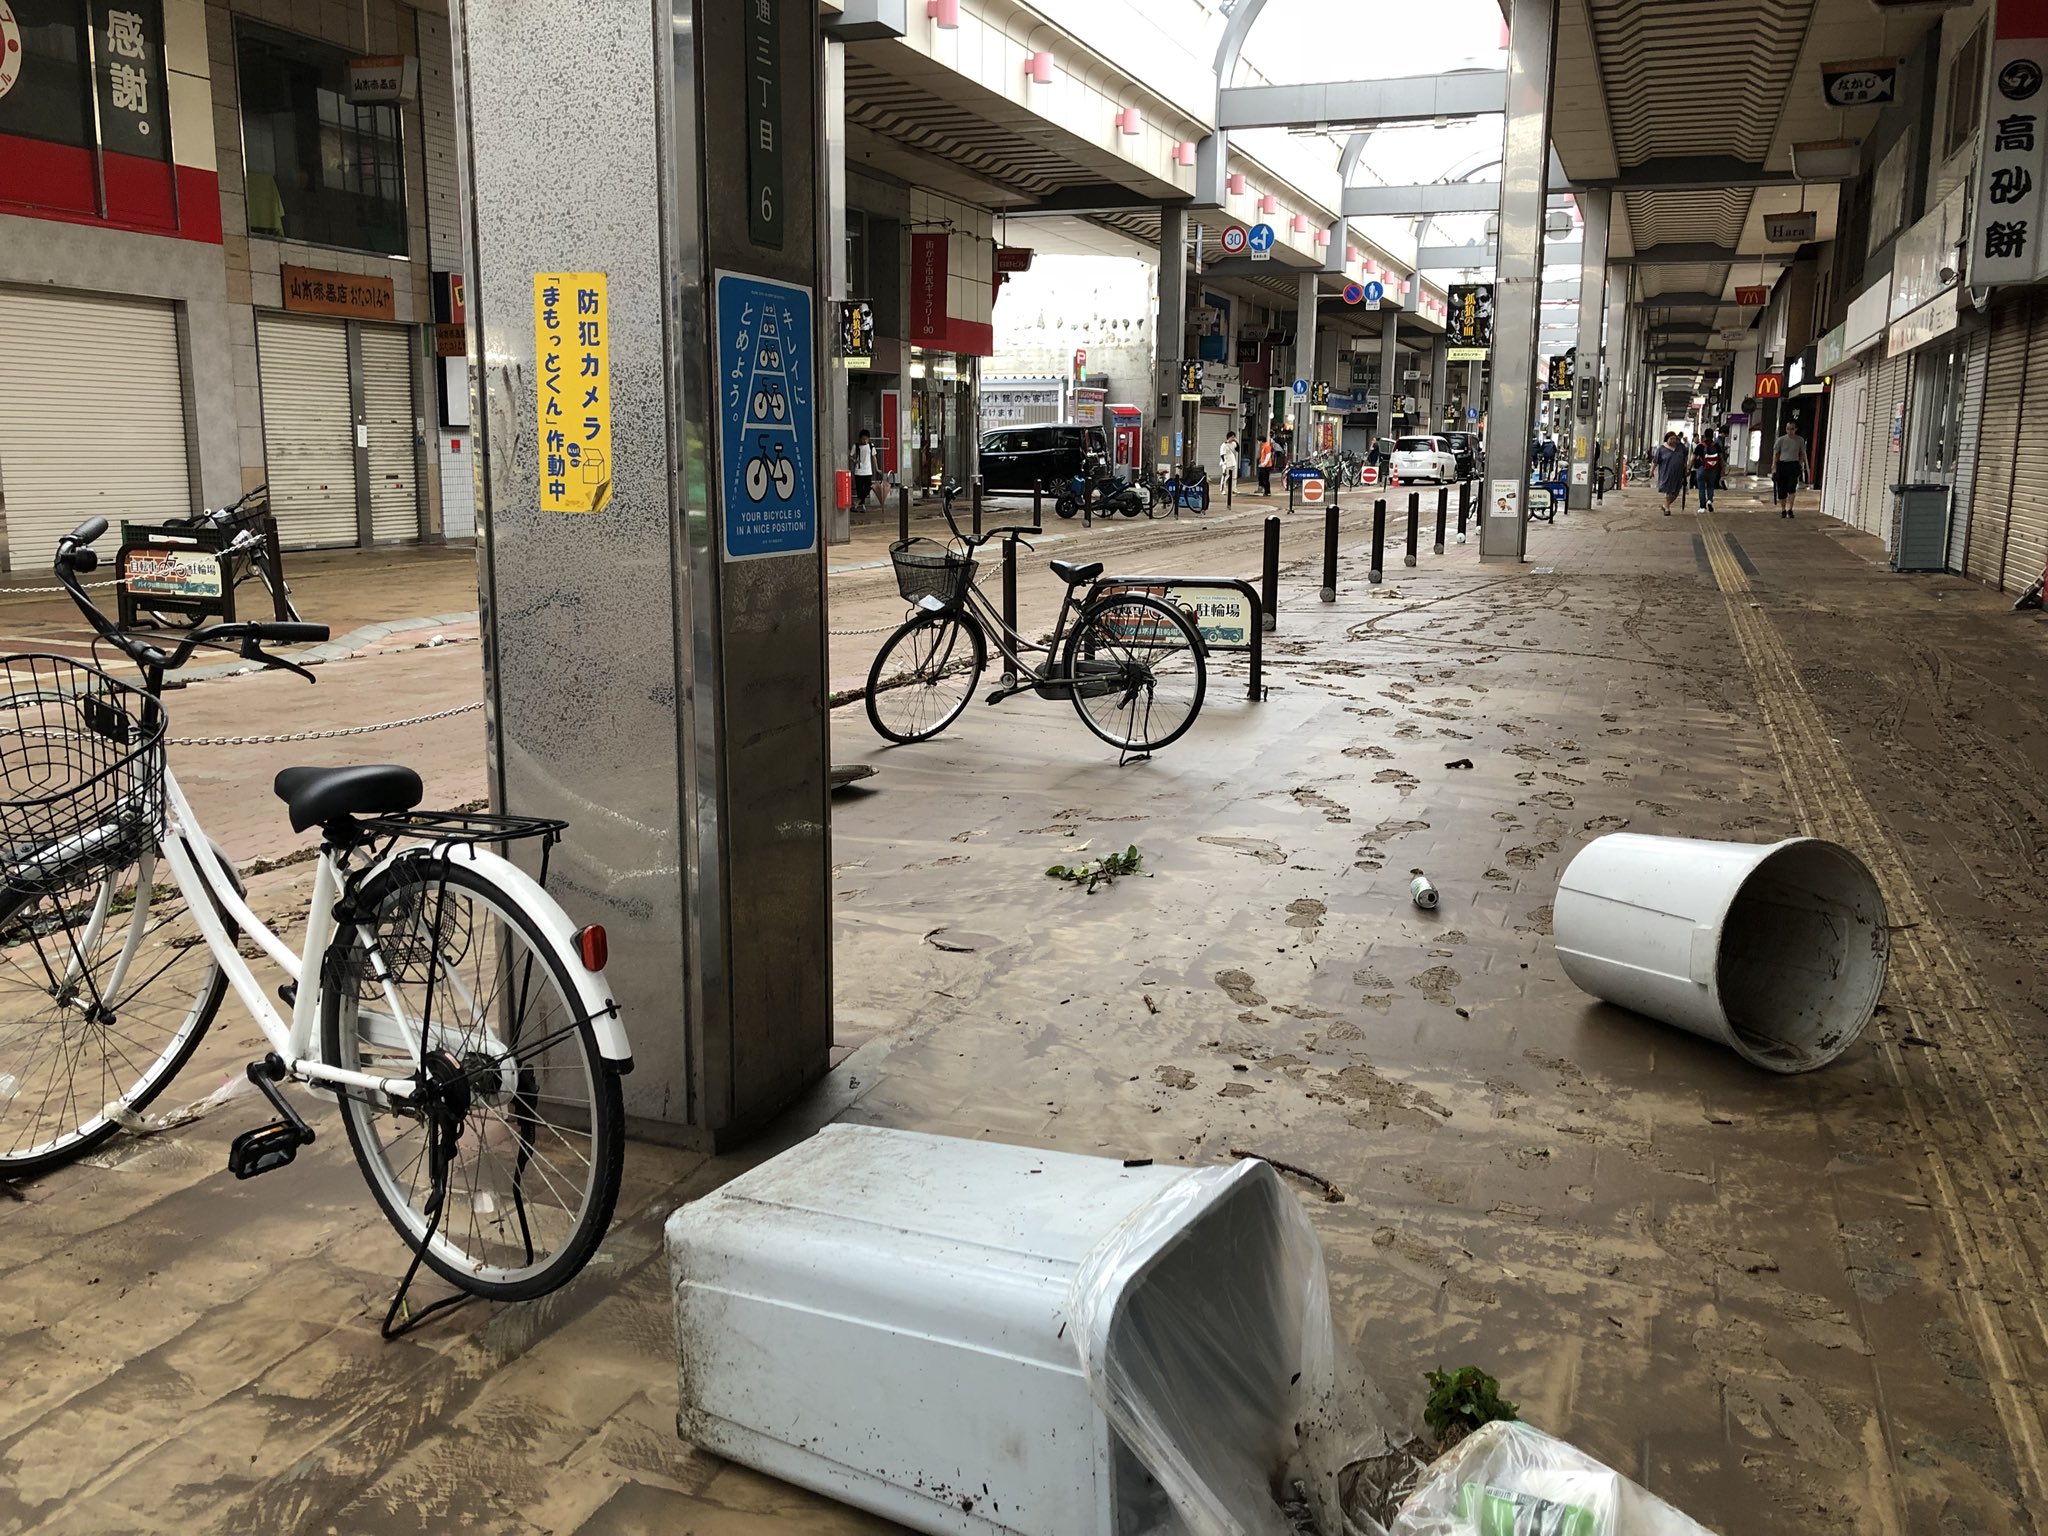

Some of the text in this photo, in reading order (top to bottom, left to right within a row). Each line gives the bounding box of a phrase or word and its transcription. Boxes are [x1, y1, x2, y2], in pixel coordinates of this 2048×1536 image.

[107, 9, 150, 136] 感謝。
[760, 186, 773, 222] 6
[1984, 113, 2037, 259] 高砂餅
[1227, 233, 1242, 247] 30
[1772, 225, 1805, 238] Hara
[577, 288, 602, 441] 防犯カメラ
[729, 302, 752, 423] とめよう。
[783, 307, 806, 406] キレイに
[736, 522, 807, 535] IN A NICE POSITION!
[741, 509, 801, 522] YOUR BICYCLE IS
[1196, 602, 1241, 618] 駐輪場
